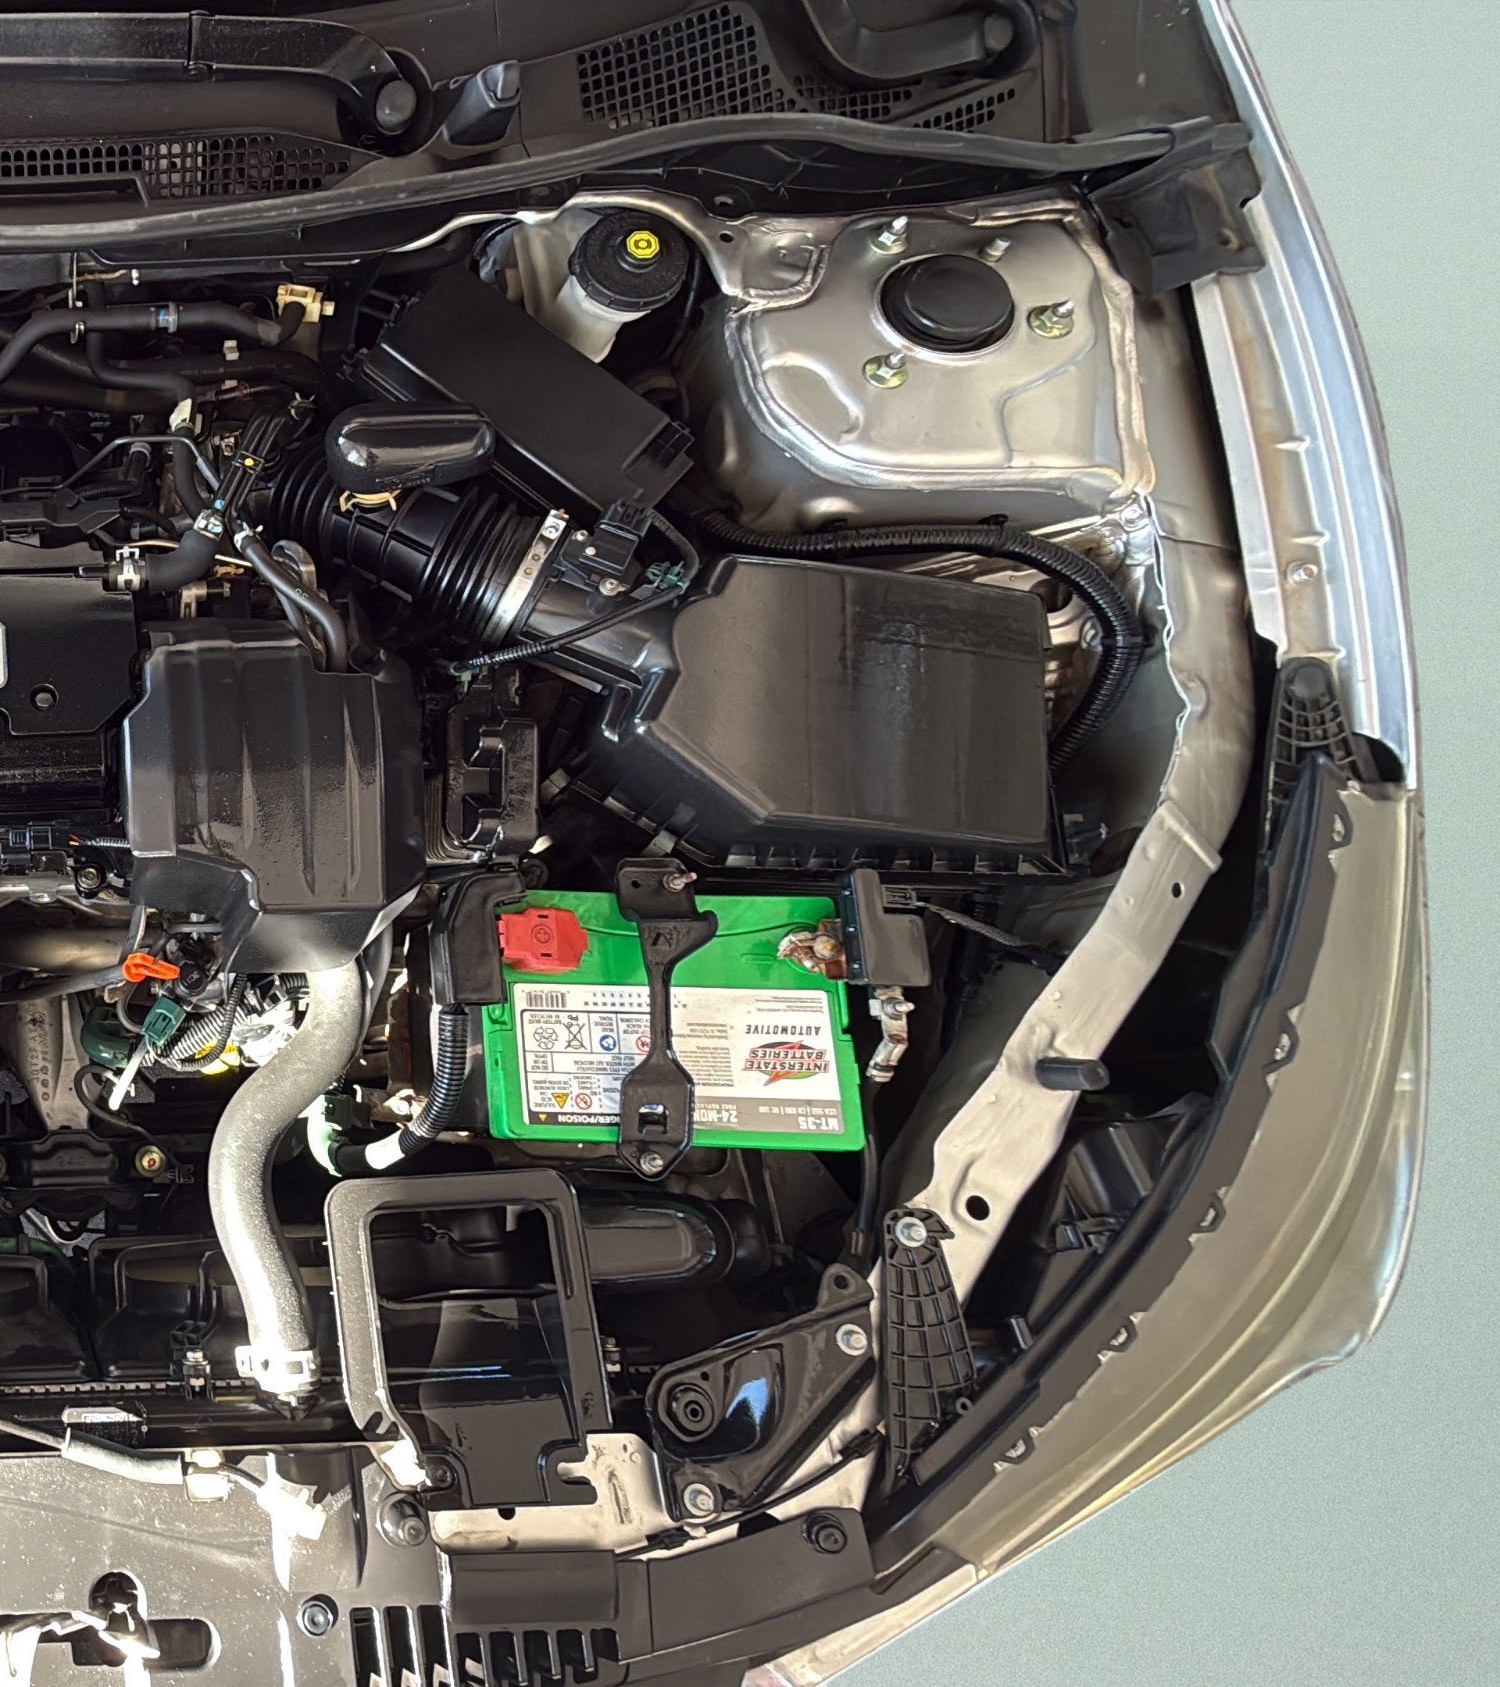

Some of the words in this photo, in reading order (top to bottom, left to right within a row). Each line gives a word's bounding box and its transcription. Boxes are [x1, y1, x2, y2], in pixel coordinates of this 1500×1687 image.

[745, 1024, 821, 1036] AUTOMOTIVE
[750, 1049, 825, 1060] BATTERIES
[746, 1060, 829, 1072] INTERSTATE
[798, 1116, 839, 1131] MT-35
